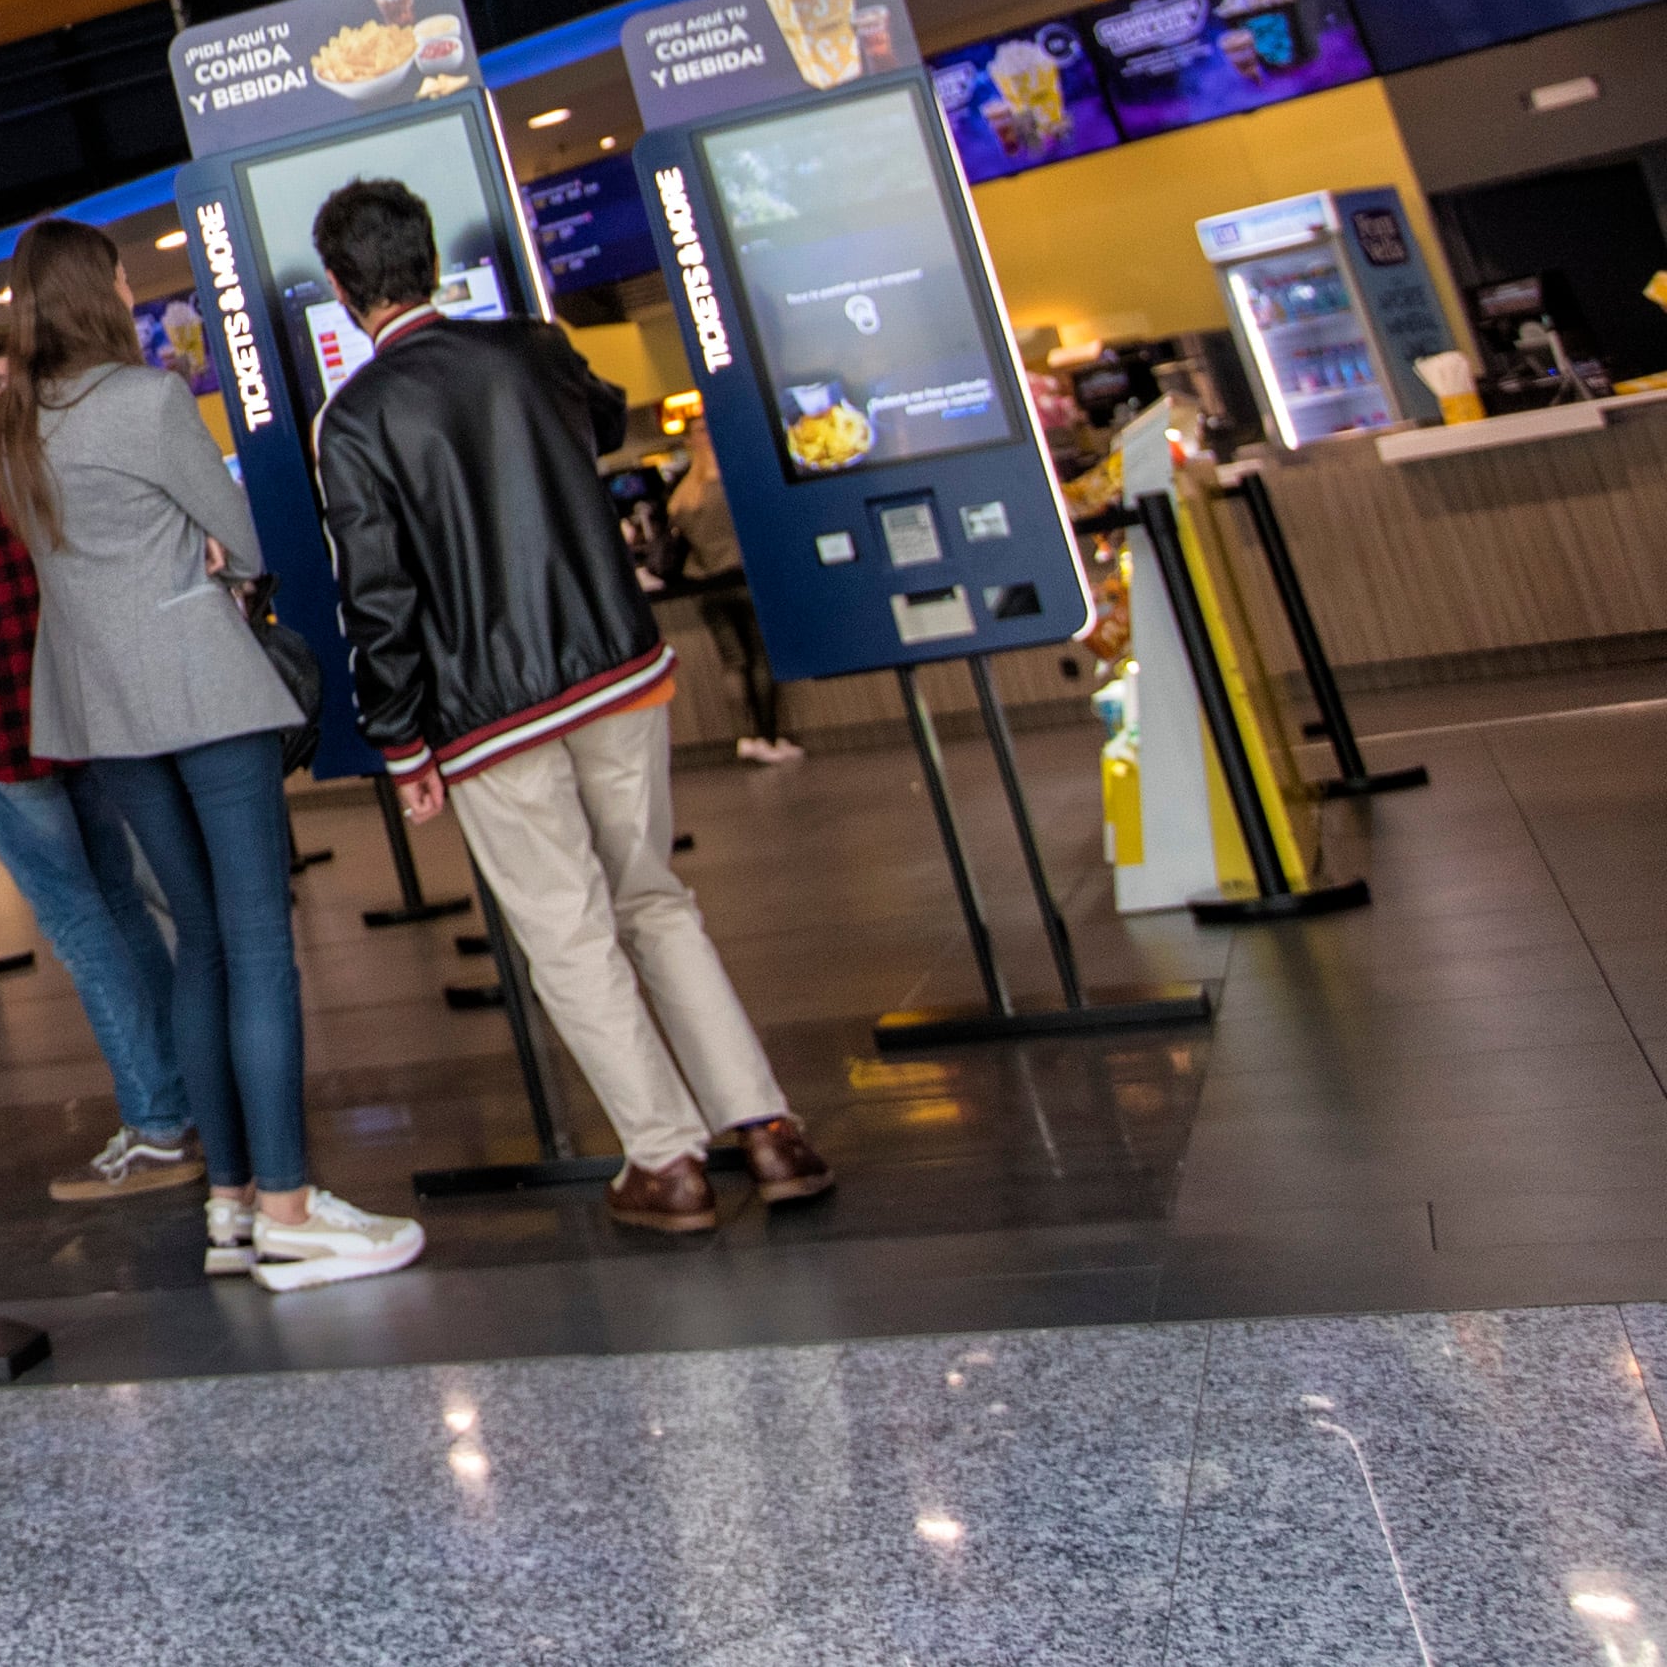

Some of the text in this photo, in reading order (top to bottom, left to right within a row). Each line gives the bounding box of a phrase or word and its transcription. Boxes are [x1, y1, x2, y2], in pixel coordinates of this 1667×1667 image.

[184, 21, 290, 67] ¡PIDE AQUÍ TU
[645, 5, 748, 46] ¡PIDE AQUÍ TU
[655, 19, 750, 63] COMIDA
[195, 43, 292, 86] COMIDA
[651, 43, 766, 90] Y BEBIDA!
[189, 65, 308, 116] Y BEBIDA!
[196, 200, 272, 434] TICKETS & MORE
